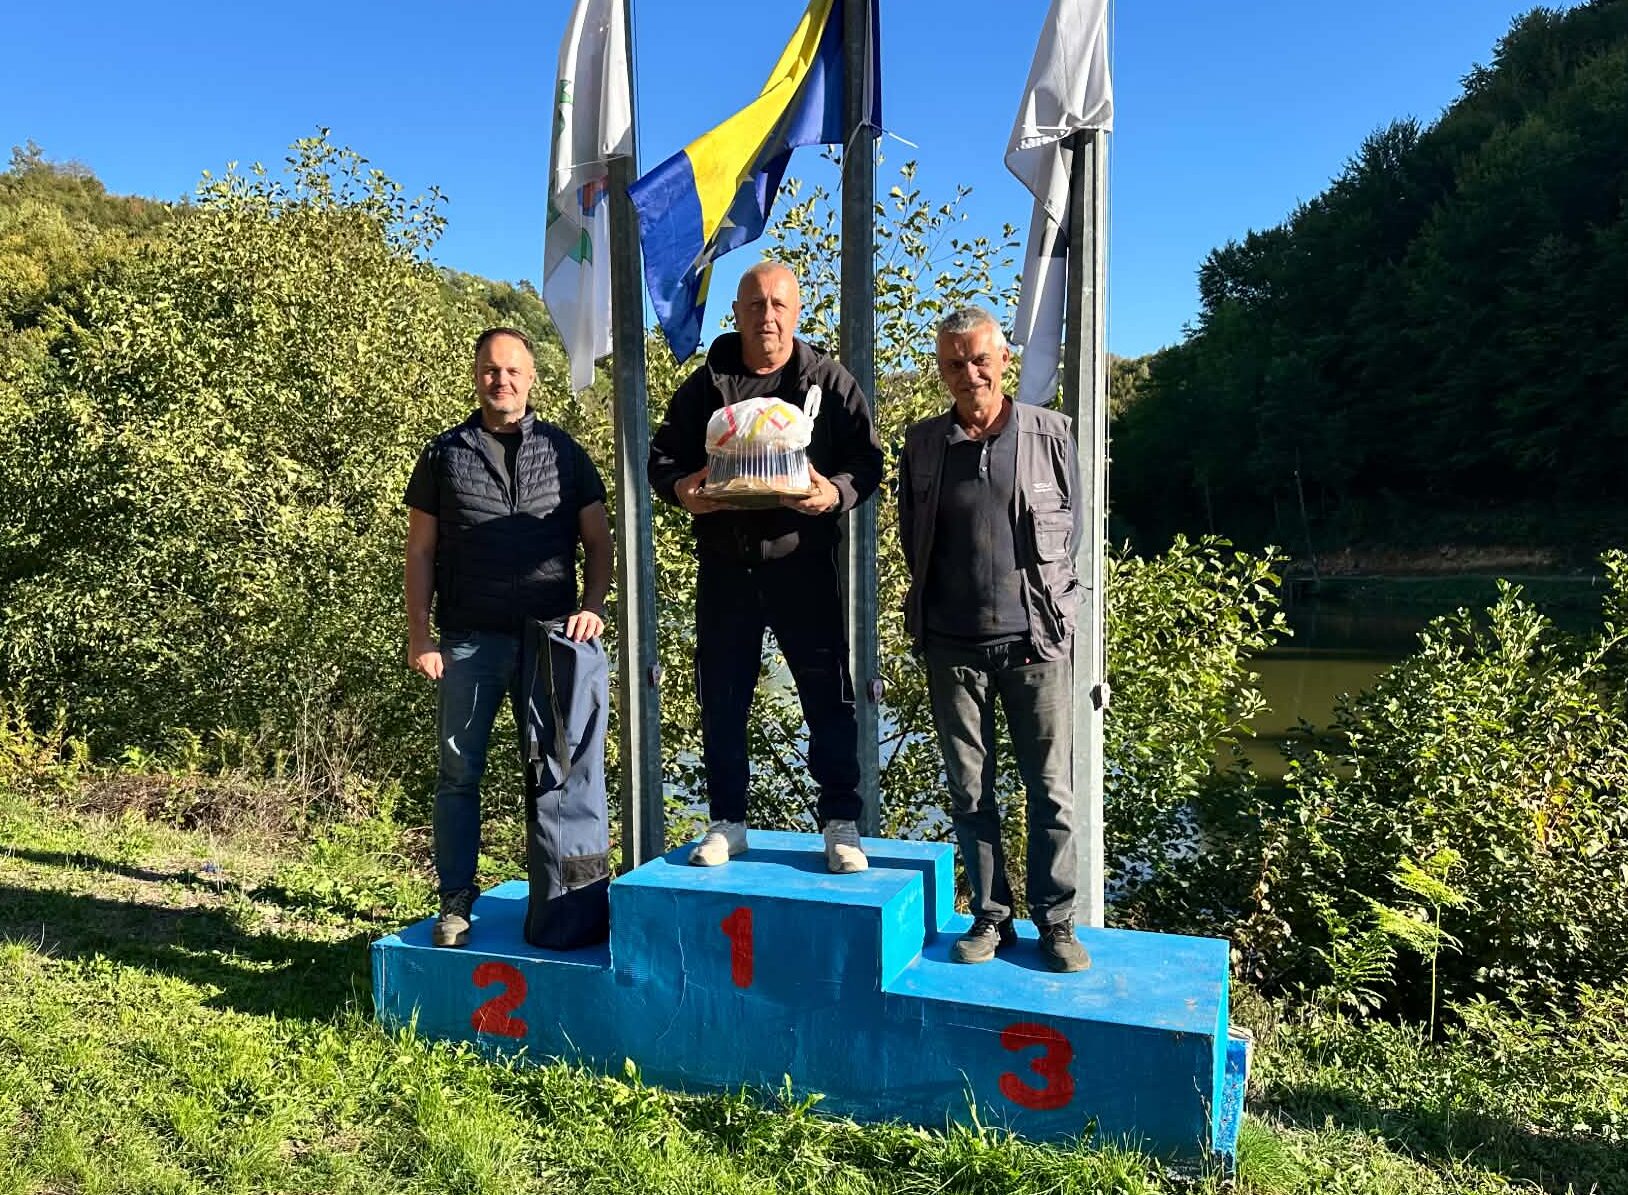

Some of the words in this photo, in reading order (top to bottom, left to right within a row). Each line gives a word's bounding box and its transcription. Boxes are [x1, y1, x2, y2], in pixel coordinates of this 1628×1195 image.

[721, 907, 753, 988] 1
[471, 962, 528, 1038] 2
[999, 1023, 1075, 1110] 3
